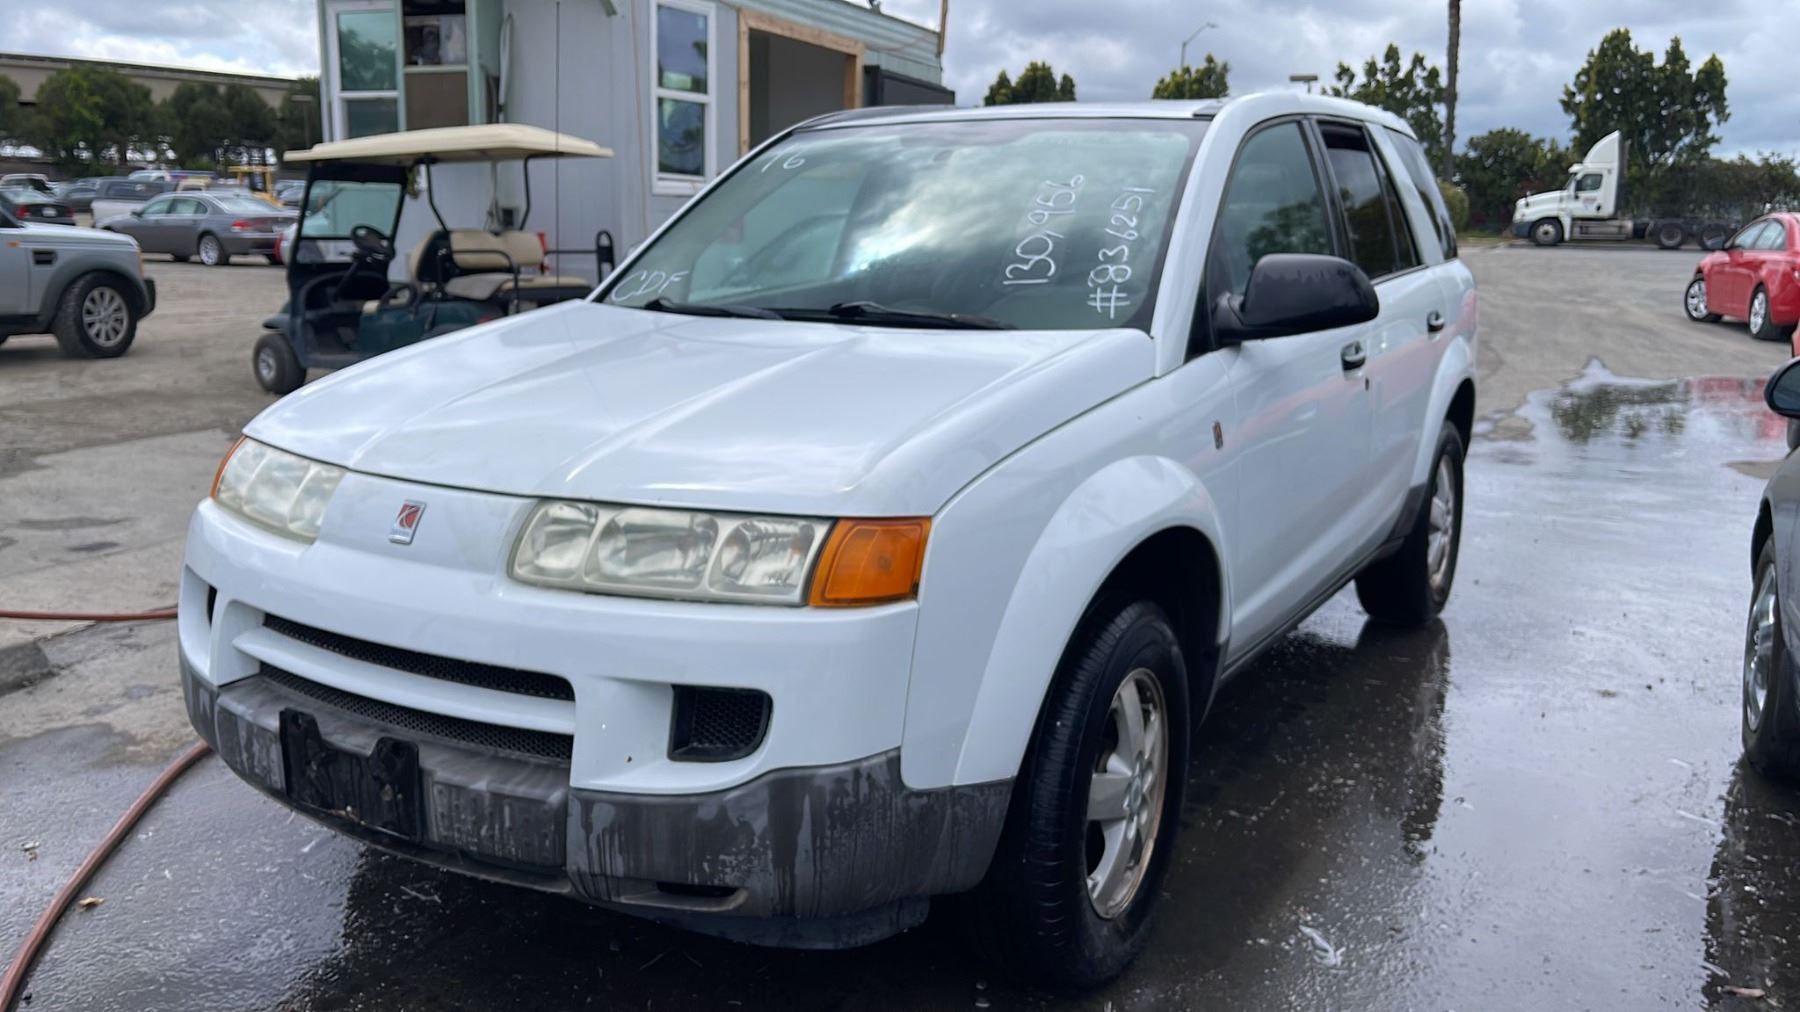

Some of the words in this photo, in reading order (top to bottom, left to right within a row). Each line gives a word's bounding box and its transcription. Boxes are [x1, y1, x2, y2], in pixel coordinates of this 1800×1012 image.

[1003, 174, 1084, 285] 130,956
[1087, 187, 1157, 319] #836251
[611, 269, 689, 302] CDF
